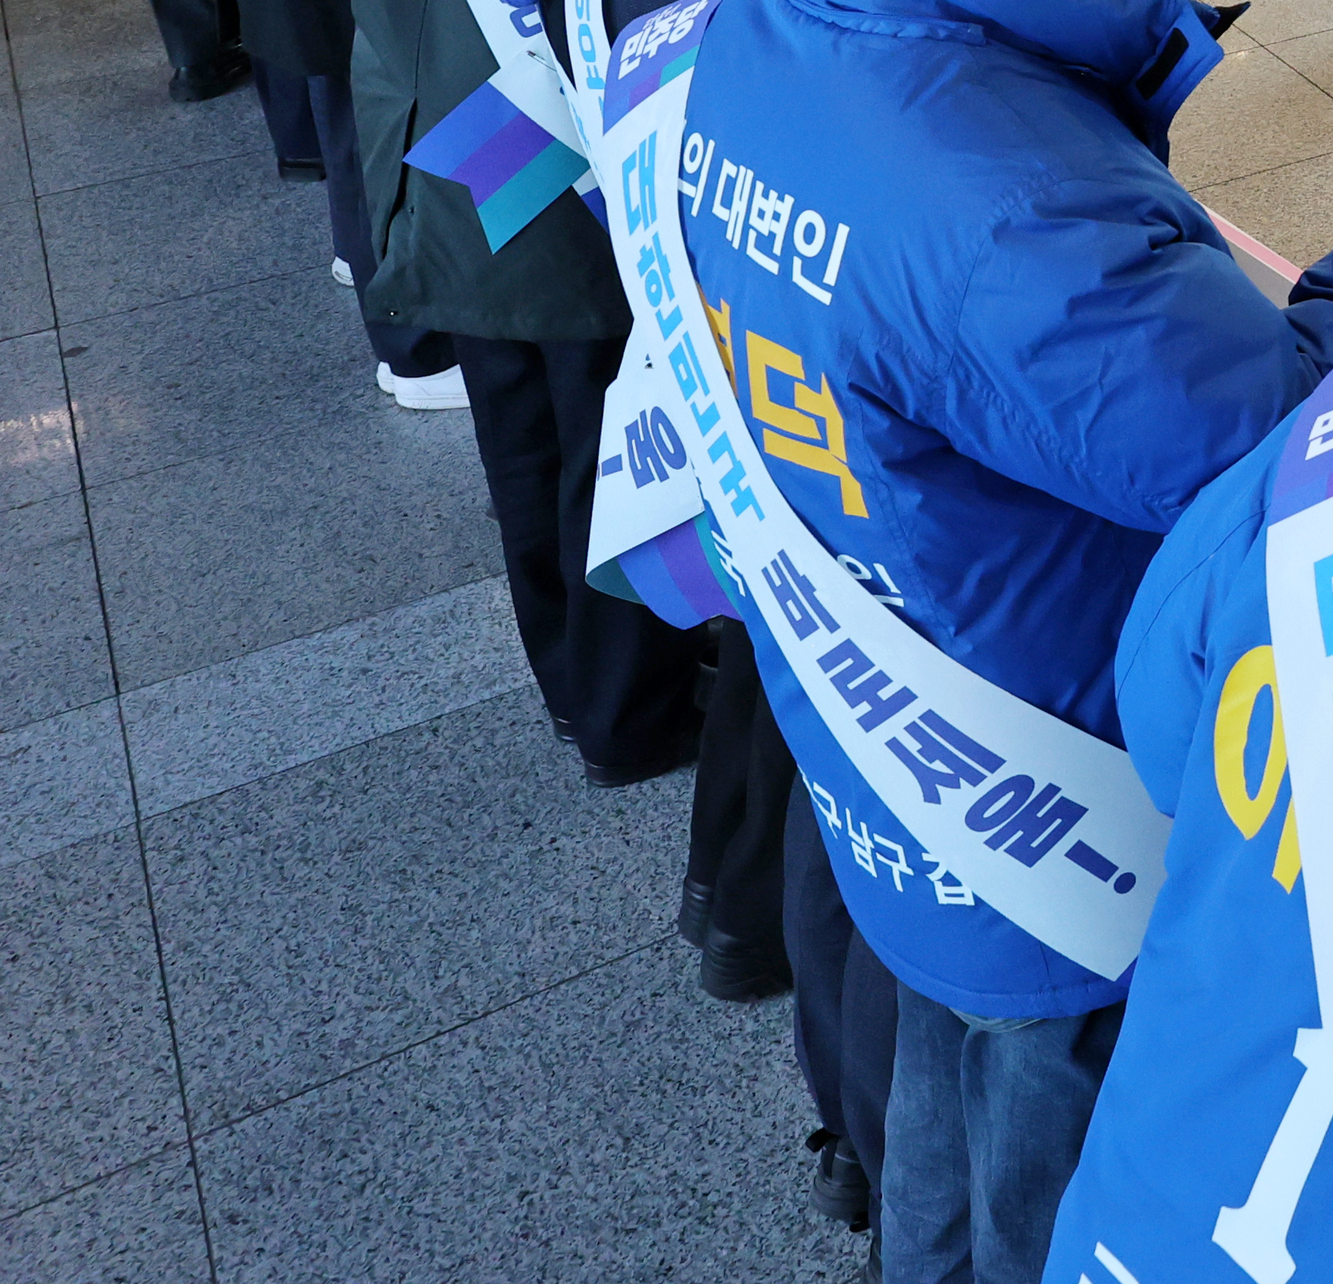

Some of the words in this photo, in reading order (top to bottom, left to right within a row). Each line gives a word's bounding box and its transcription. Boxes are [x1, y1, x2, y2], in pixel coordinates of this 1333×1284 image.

[677, 132, 716, 217] 의
[711, 158, 851, 306] 대변인
[621, 130, 767, 523] 대한민국
[760, 549, 1138, 895] 바로세움!
